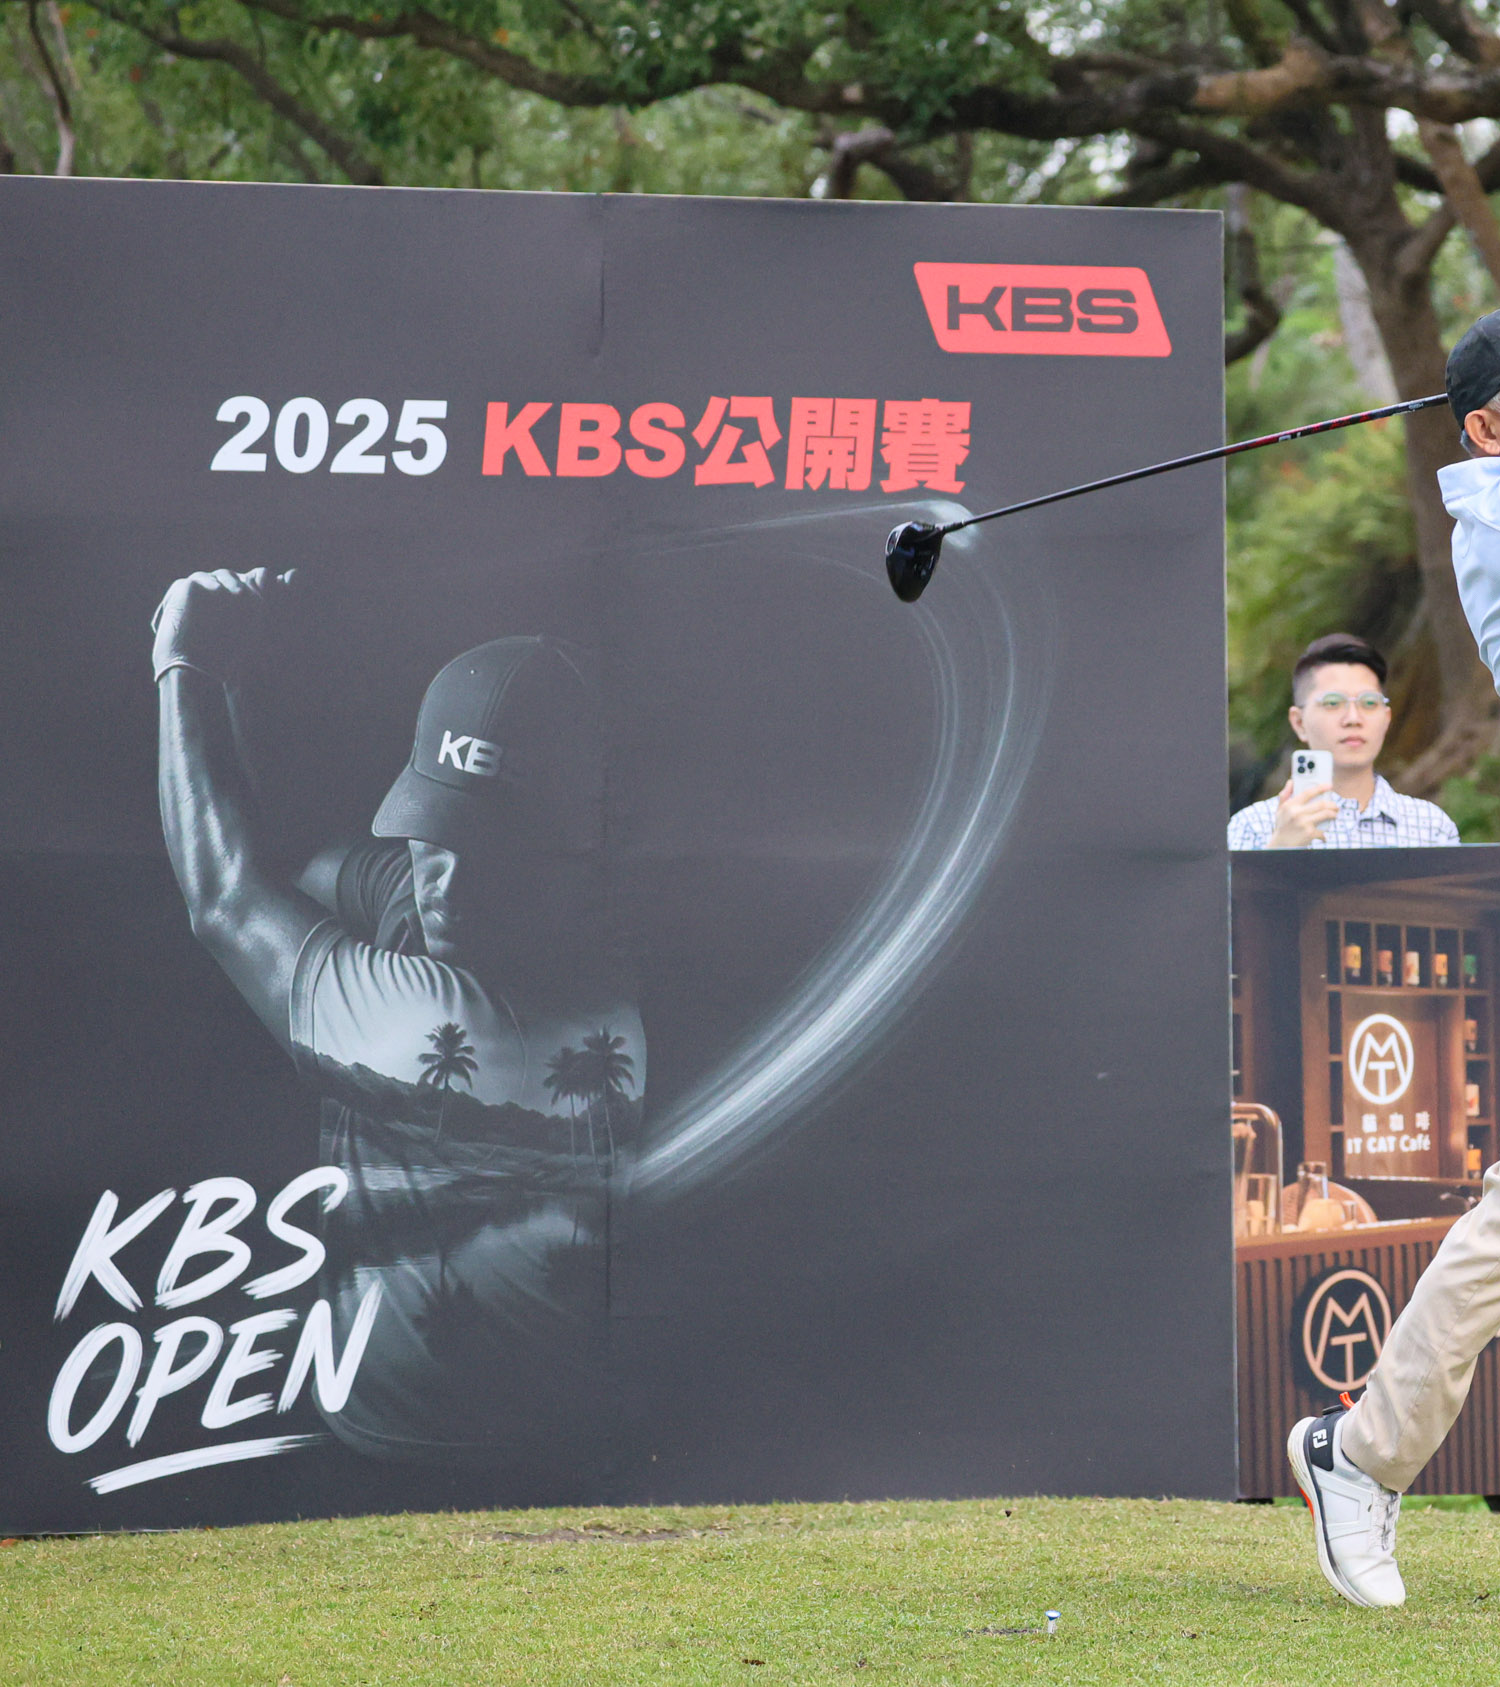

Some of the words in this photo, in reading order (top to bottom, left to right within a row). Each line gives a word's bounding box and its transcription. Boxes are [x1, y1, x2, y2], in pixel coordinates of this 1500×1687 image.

[946, 284, 1140, 334] KBS
[210, 395, 448, 476] 2025
[481, 395, 972, 495] KBS公開賽
[1347, 1137, 1362, 1154] IT
[1367, 1136, 1396, 1154] CAT
[54, 1165, 349, 1323] KBS
[47, 1278, 385, 1454] OPEN
